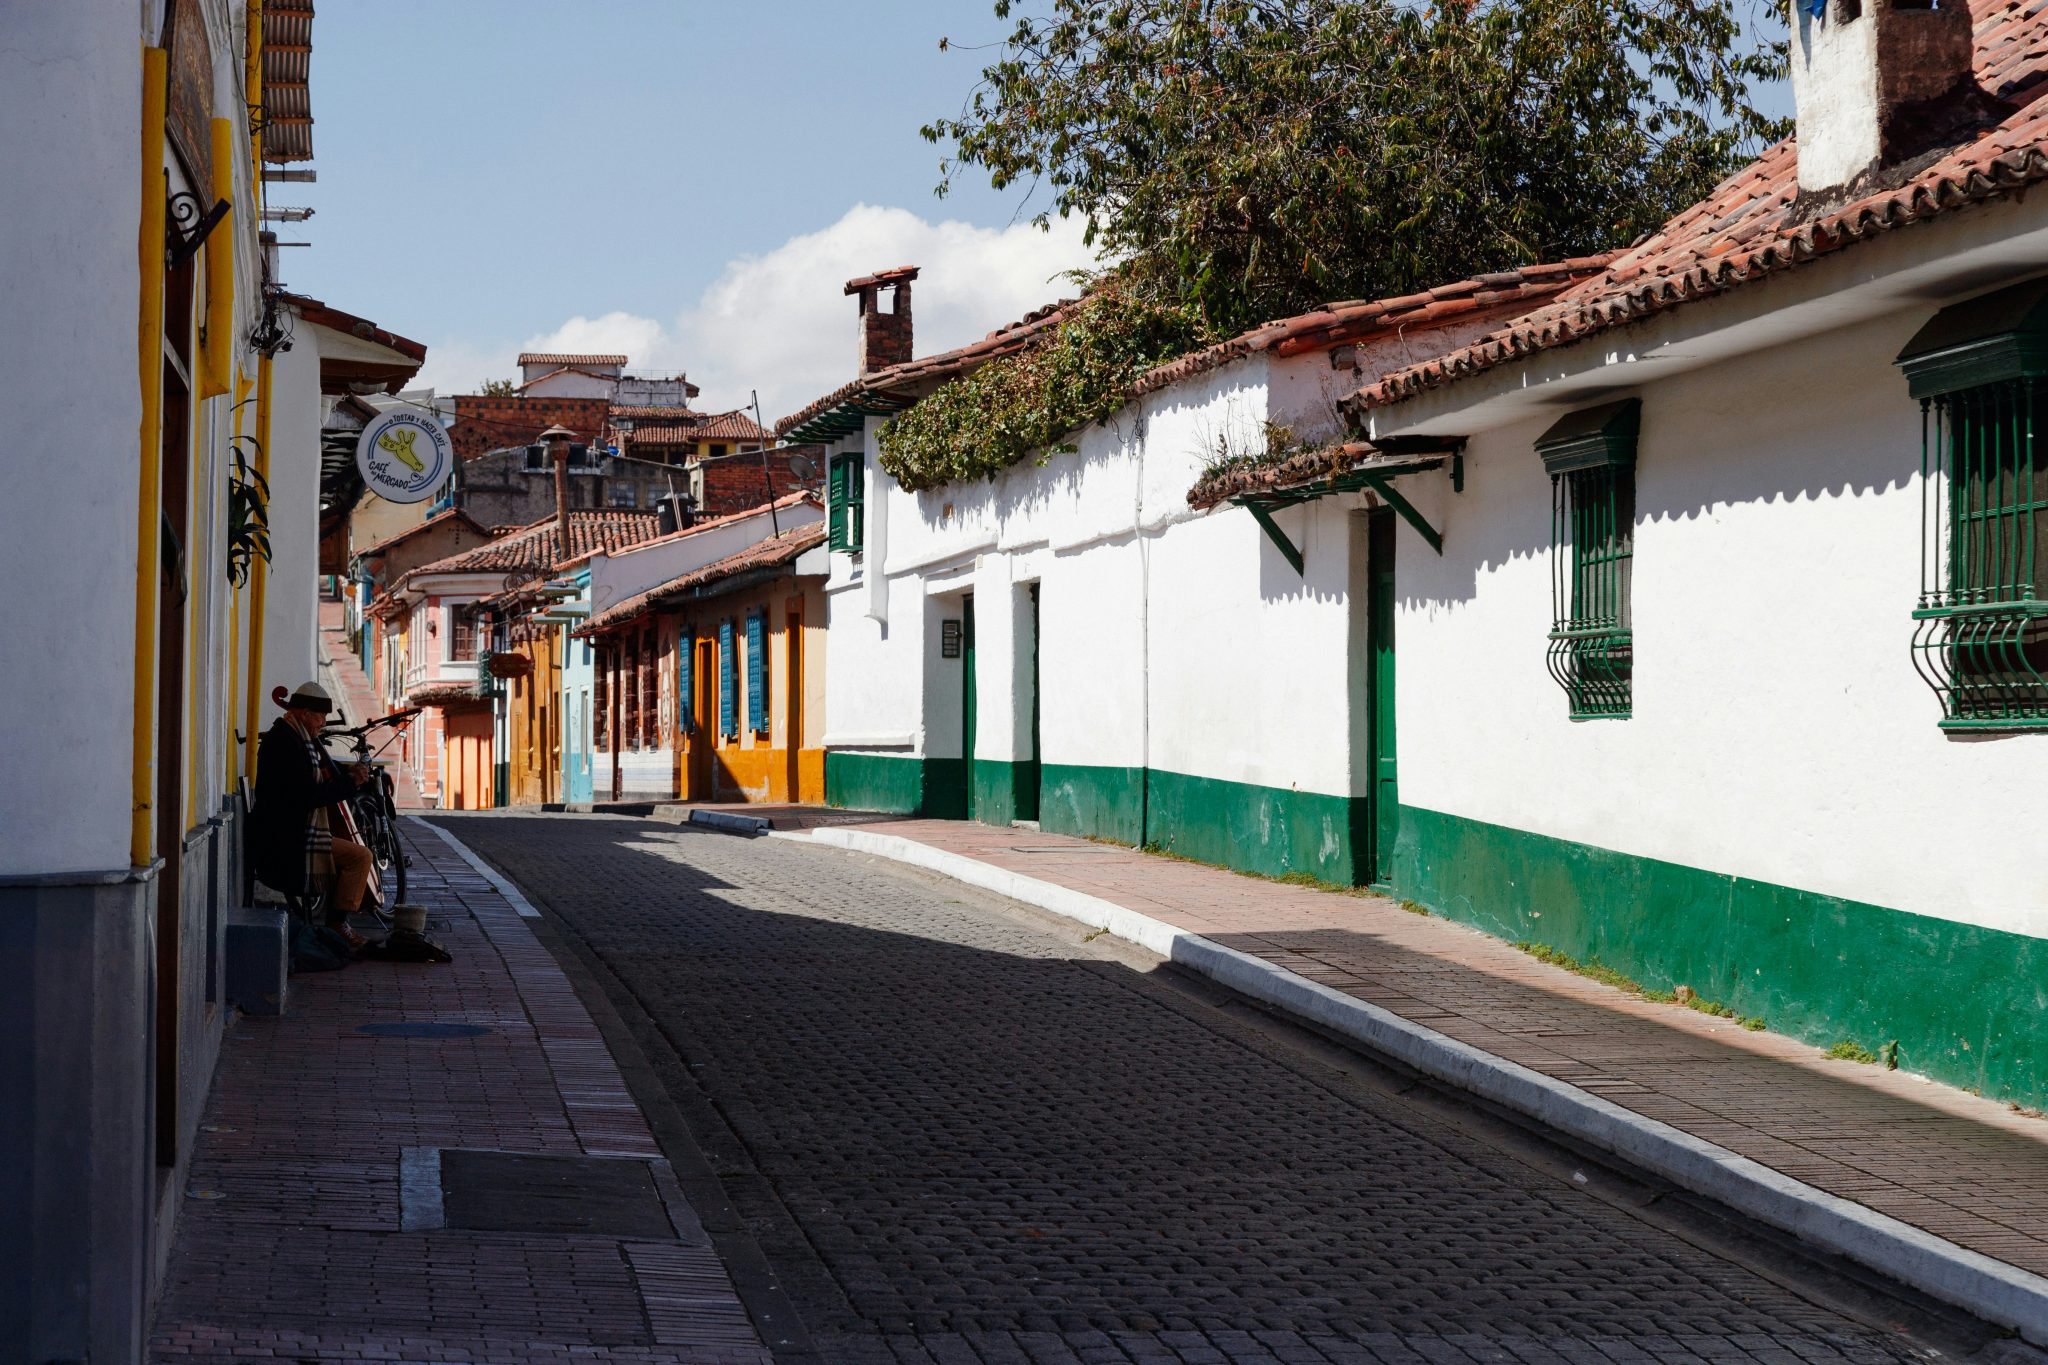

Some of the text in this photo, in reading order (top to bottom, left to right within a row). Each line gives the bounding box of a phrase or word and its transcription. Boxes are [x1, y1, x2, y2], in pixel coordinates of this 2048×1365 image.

[421, 419, 437, 434] HACER
[434, 433, 448, 447] CAFÉ
[373, 473, 409, 489] MERCADO
